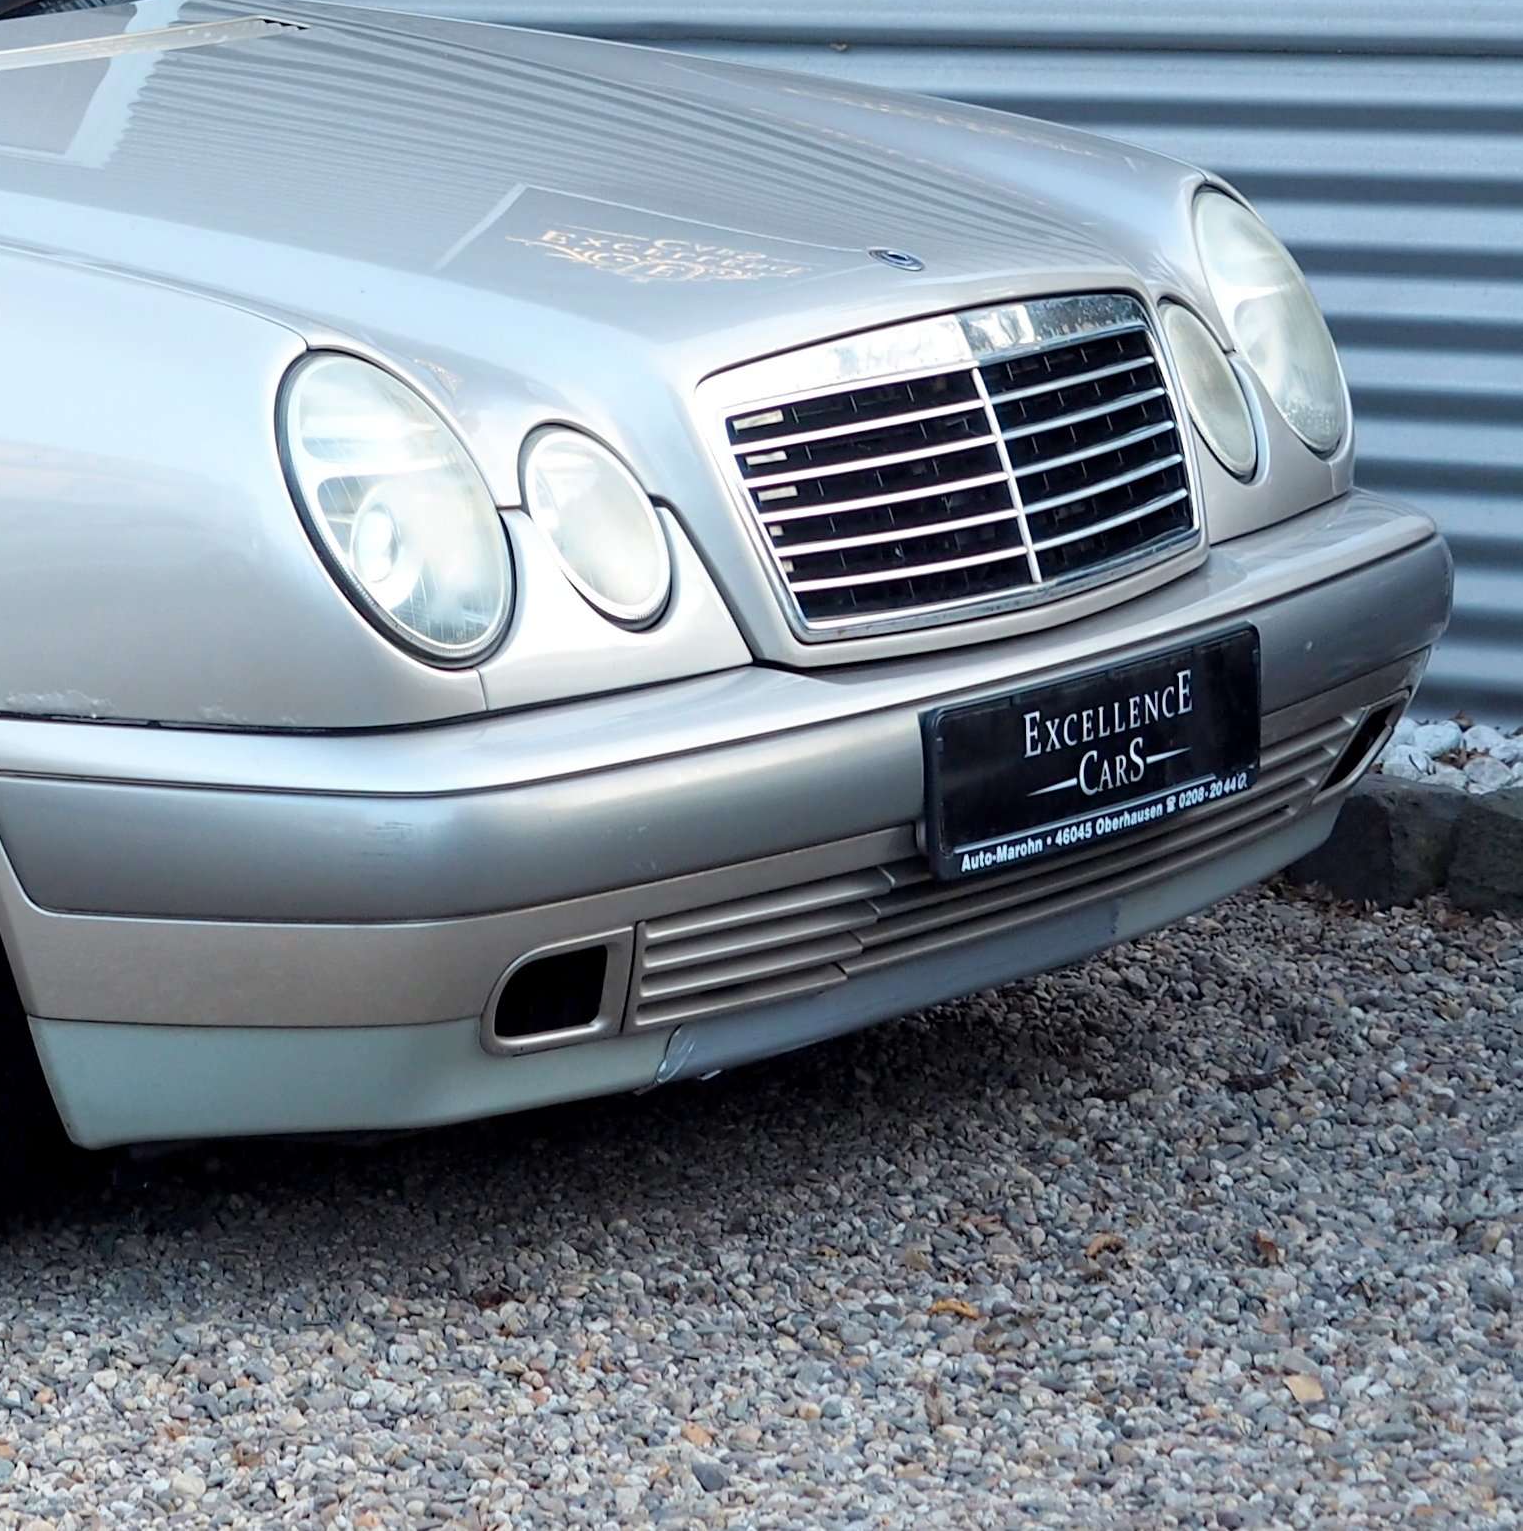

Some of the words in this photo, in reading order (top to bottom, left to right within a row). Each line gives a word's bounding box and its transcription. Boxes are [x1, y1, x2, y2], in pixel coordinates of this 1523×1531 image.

[1023, 669, 1193, 758] EXCELLENCE
[1079, 737, 1145, 796] CARS
[961, 837, 1044, 872] Auto-Marohn
[1055, 821, 1092, 847] 46045
[1095, 803, 1163, 835] Oberhausen
